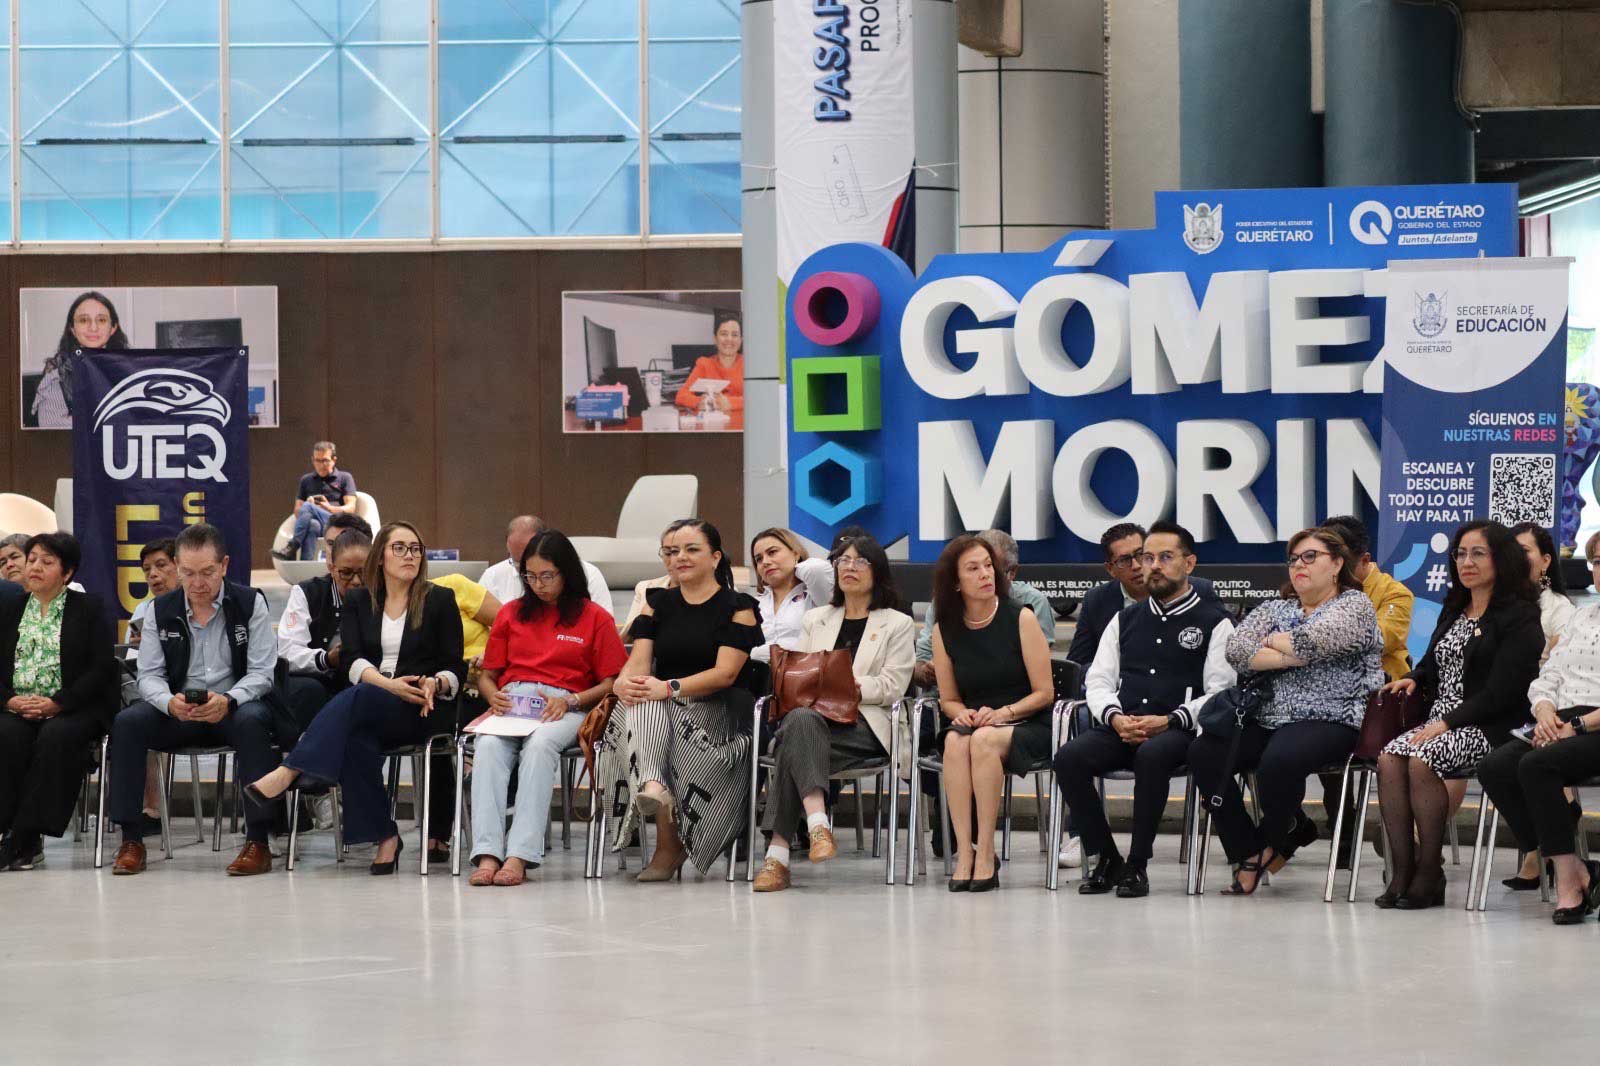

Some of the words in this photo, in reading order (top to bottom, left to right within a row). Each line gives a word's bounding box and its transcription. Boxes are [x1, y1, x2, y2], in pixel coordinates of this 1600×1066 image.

[860, 0, 880, 52] PRO
[1394, 201, 1485, 219] QUERÉTARO
[1235, 227, 1313, 243] QUERÉTARO
[1456, 303, 1518, 316] SECRETARÍA
[1520, 305, 1535, 315] DE
[900, 240, 1385, 399] GÓME
[1456, 315, 1546, 333] EDUCACIÓN
[1468, 410, 1535, 425] SÍGUENOS
[1538, 412, 1557, 425] EN
[1444, 429, 1511, 441] NUESTRAS
[1514, 429, 1556, 441] REDES
[102, 423, 229, 482] UTEQ
[1402, 462, 1463, 474] ESCANEA
[1467, 462, 1475, 474] Y
[1407, 478, 1475, 490] DESCUBRE
[1388, 494, 1424, 506] TODO
[1427, 494, 1444, 506] LO
[1447, 494, 1475, 506] QUE
[1396, 510, 1423, 522] HAY
[1426, 510, 1460, 522] PARA
[1212, 580, 1251, 588] POLITICO
[1042, 590, 1064, 598] PARA
[1219, 590, 1230, 598] EN
[1232, 590, 1243, 598] EL
